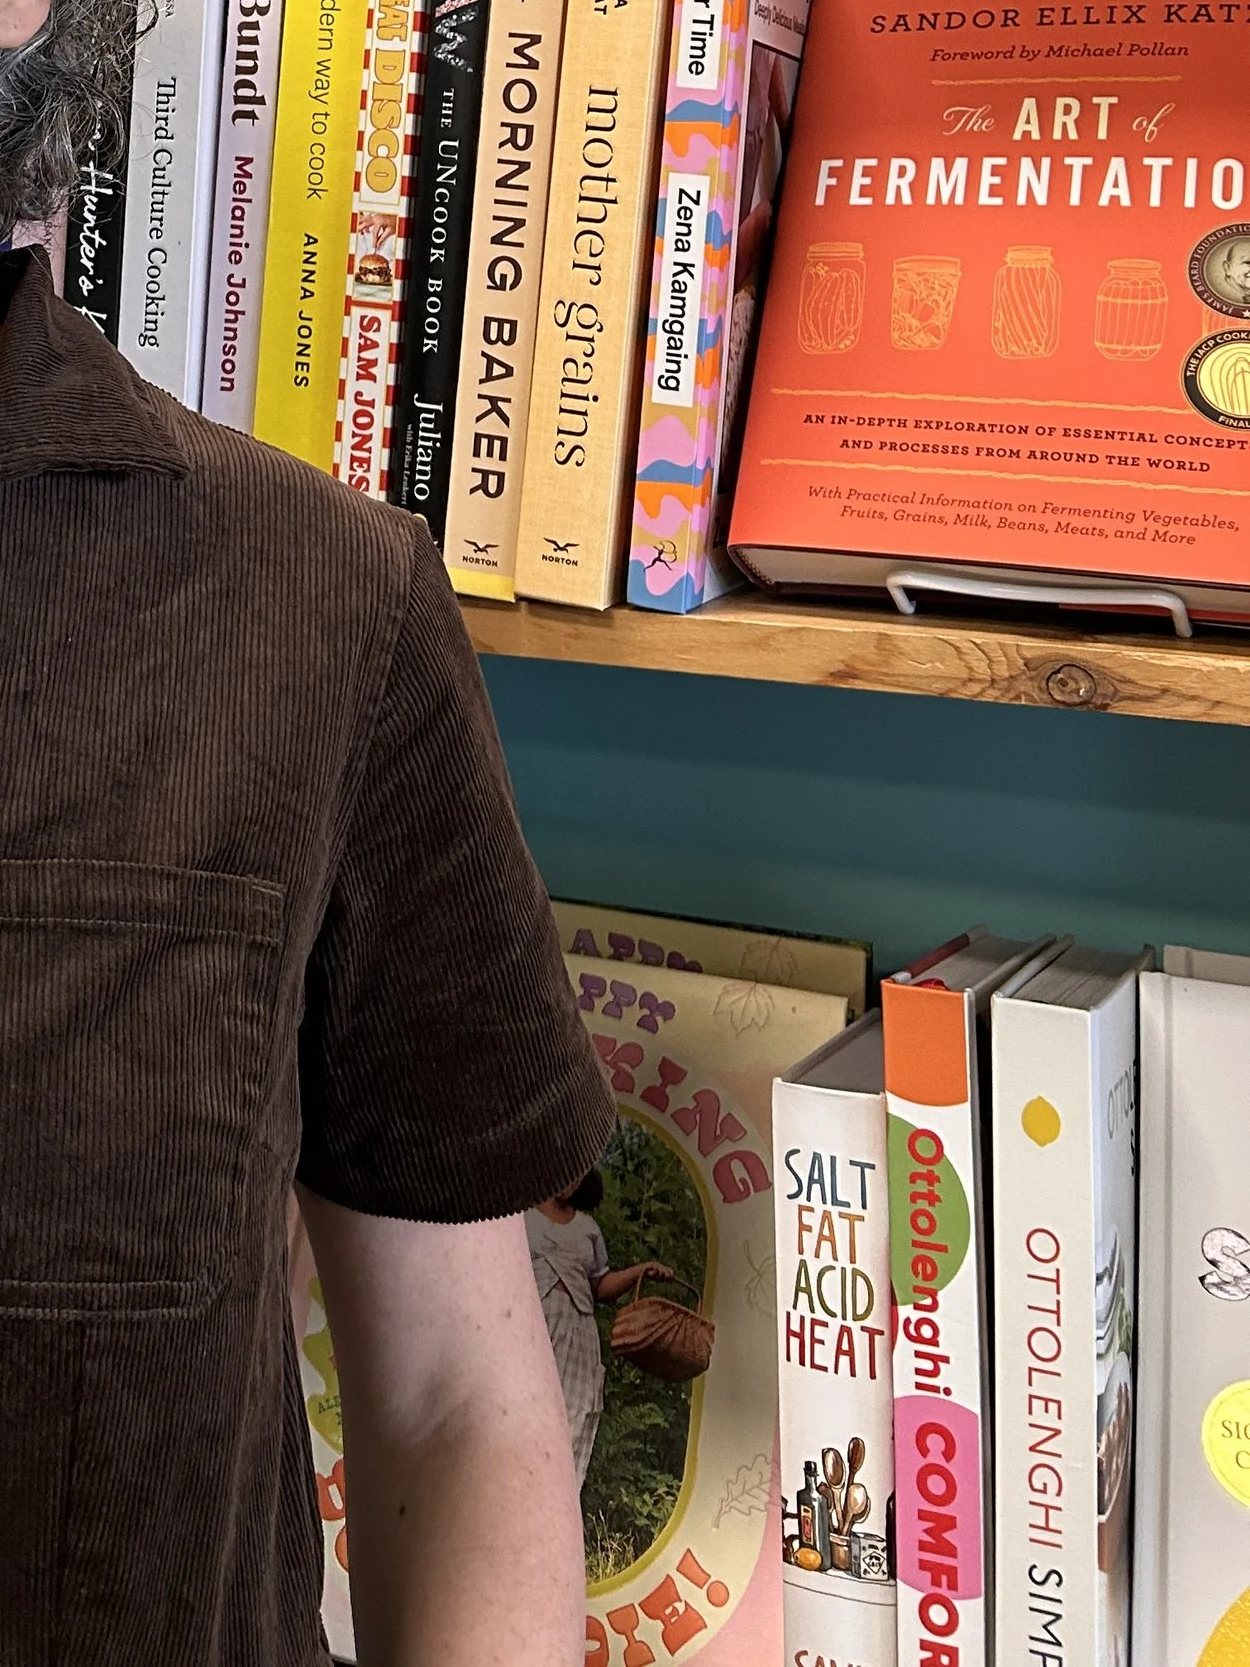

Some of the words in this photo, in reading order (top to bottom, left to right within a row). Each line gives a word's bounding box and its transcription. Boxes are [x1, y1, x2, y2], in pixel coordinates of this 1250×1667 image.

[688, 13, 715, 76] Time
[869, 8, 1021, 34] SANDOR
[1036, 4, 1147, 27] ELLIX
[1163, 2, 1250, 25] KAT
[929, 45, 1017, 63] Foreword
[1019, 44, 1041, 63] by
[1045, 42, 1122, 60] Michael
[1127, 41, 1189, 58] Pollan
[154, 77, 177, 141] Third
[366, 48, 406, 193] DISCO
[942, 104, 994, 135] The
[1012, 96, 1119, 141] ART
[1132, 101, 1177, 143] of
[149, 148, 173, 240] Culture
[486, 32, 543, 292] MORNING
[572, 84, 619, 287] mother
[814, 155, 1245, 211] FERMENTATIO
[228, 156, 254, 266] Melanie
[673, 187, 701, 253] Zena
[138, 247, 168, 349] Cooking
[299, 233, 319, 301] ANNA
[219, 273, 247, 392] Johnson
[293, 310, 313, 388] JONES
[658, 261, 696, 393] Kamgaing
[468, 315, 519, 500] BAKER
[554, 298, 605, 467] grains
[413, 394, 444, 501] Juliano
[803, 414, 825, 425] AN
[829, 415, 908, 430] IN-DEPTH
[913, 418, 1030, 437] EXPLORATION
[1034, 425, 1057, 438] OF
[1062, 426, 1159, 445] ESSENTIAL
[808, 485, 842, 501] With
[846, 488, 916, 508] Practical
[918, 492, 1014, 514] Information
[1017, 502, 1038, 514] on
[1040, 500, 1137, 524] Fermenting
[1141, 508, 1242, 533] Vegetables,
[542, 554, 579, 567] NORTON
[784, 1147, 876, 1211] SALT
[797, 1204, 865, 1265] FAT
[902, 1128, 953, 1397] Ottolenghi
[792, 1258, 875, 1322] ACID
[785, 1310, 885, 1381] HEAT
[1026, 1227, 1065, 1549] OTTOLENGHI
[914, 1421, 960, 1667] COMFOR
